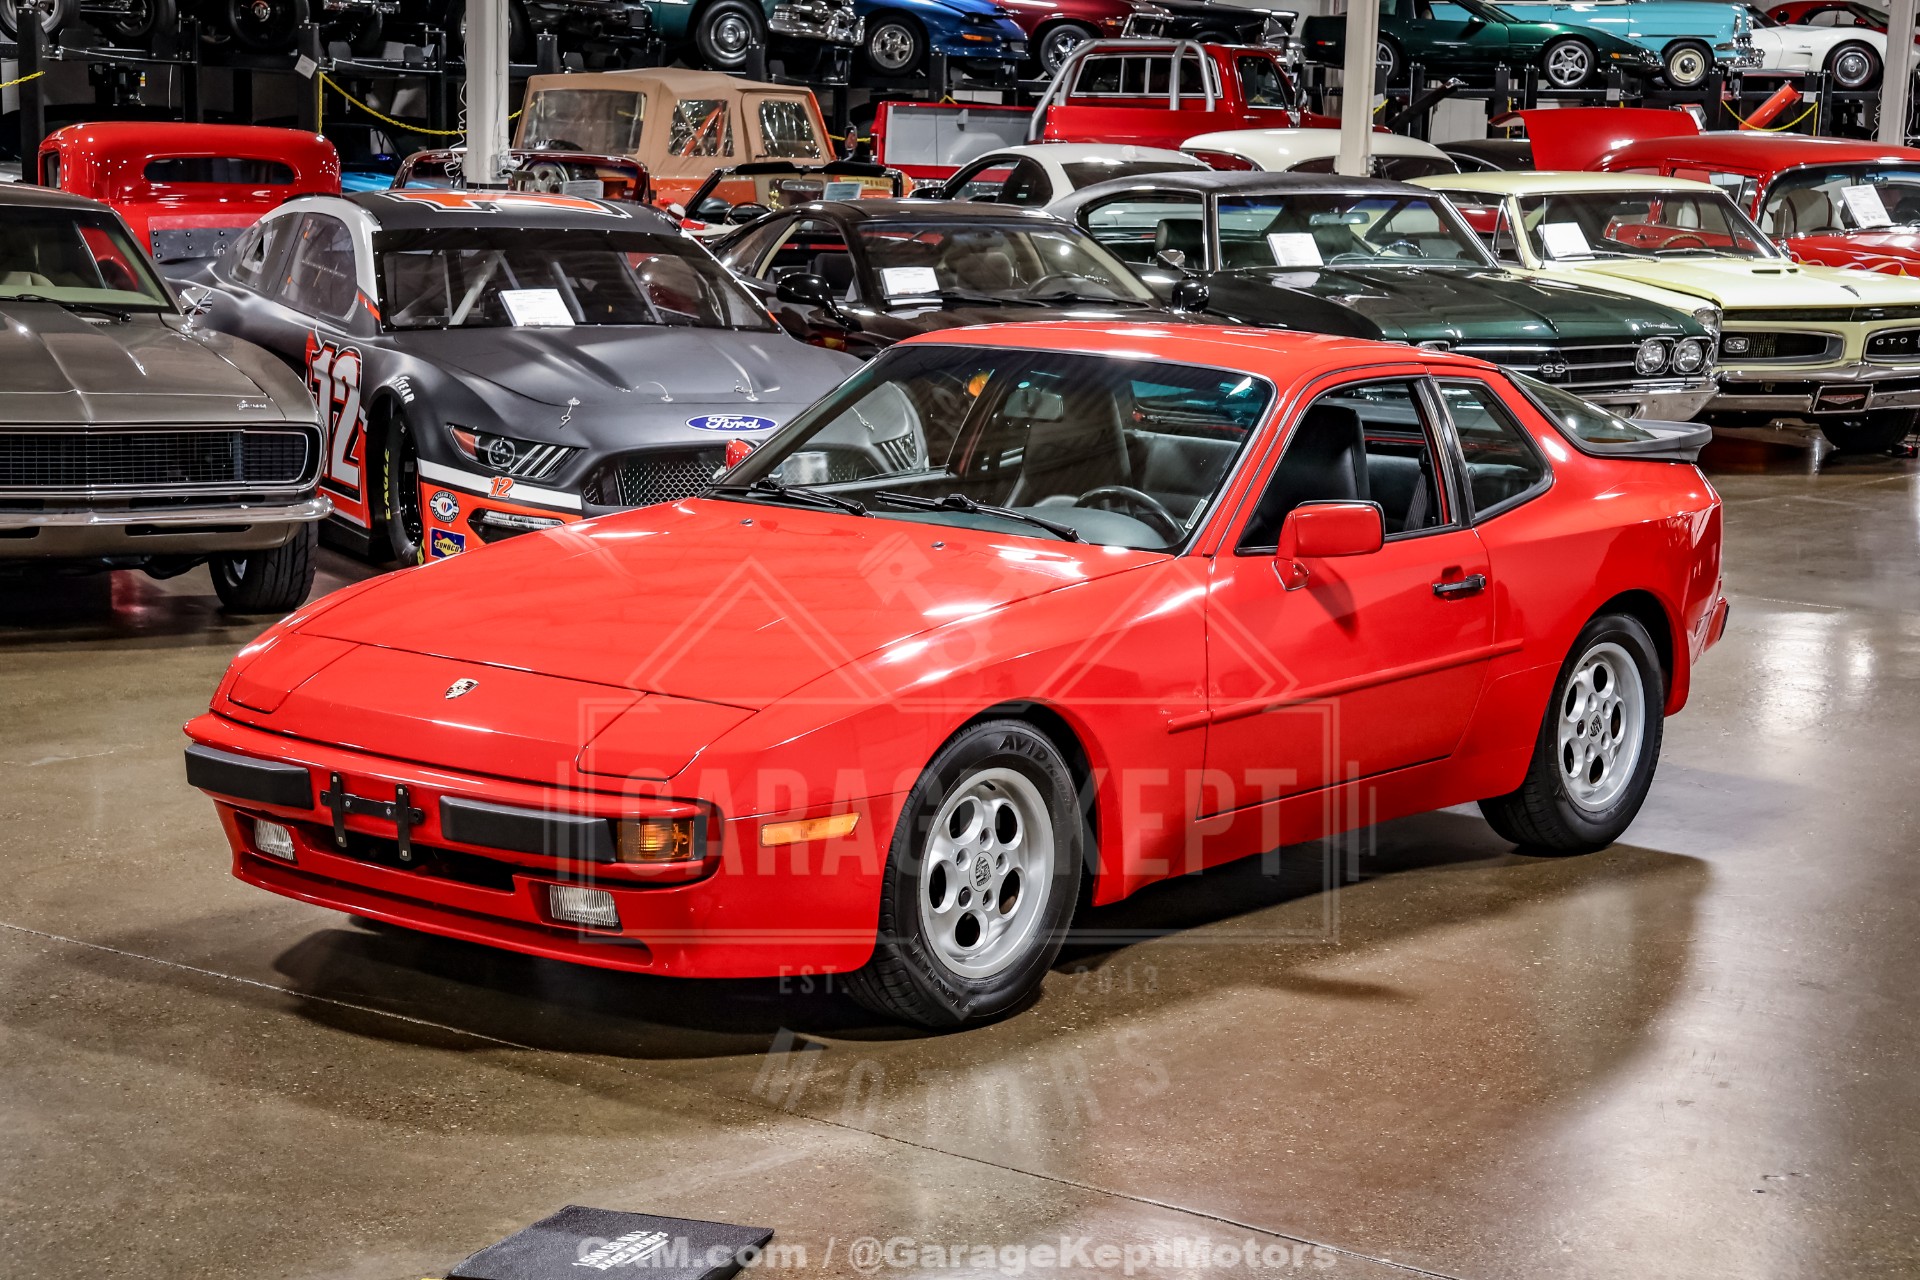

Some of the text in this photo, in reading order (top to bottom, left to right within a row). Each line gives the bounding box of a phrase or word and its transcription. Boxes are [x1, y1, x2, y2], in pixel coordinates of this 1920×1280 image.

[1876, 337, 1908, 346] GTO
[1542, 364, 1566, 374] SS
[309, 347, 361, 493] 12
[706, 416, 761, 429] Ford
[489, 476, 514, 498] 12
[435, 541, 460, 553] SUNOCO
[998, 734, 1049, 762] AVID
